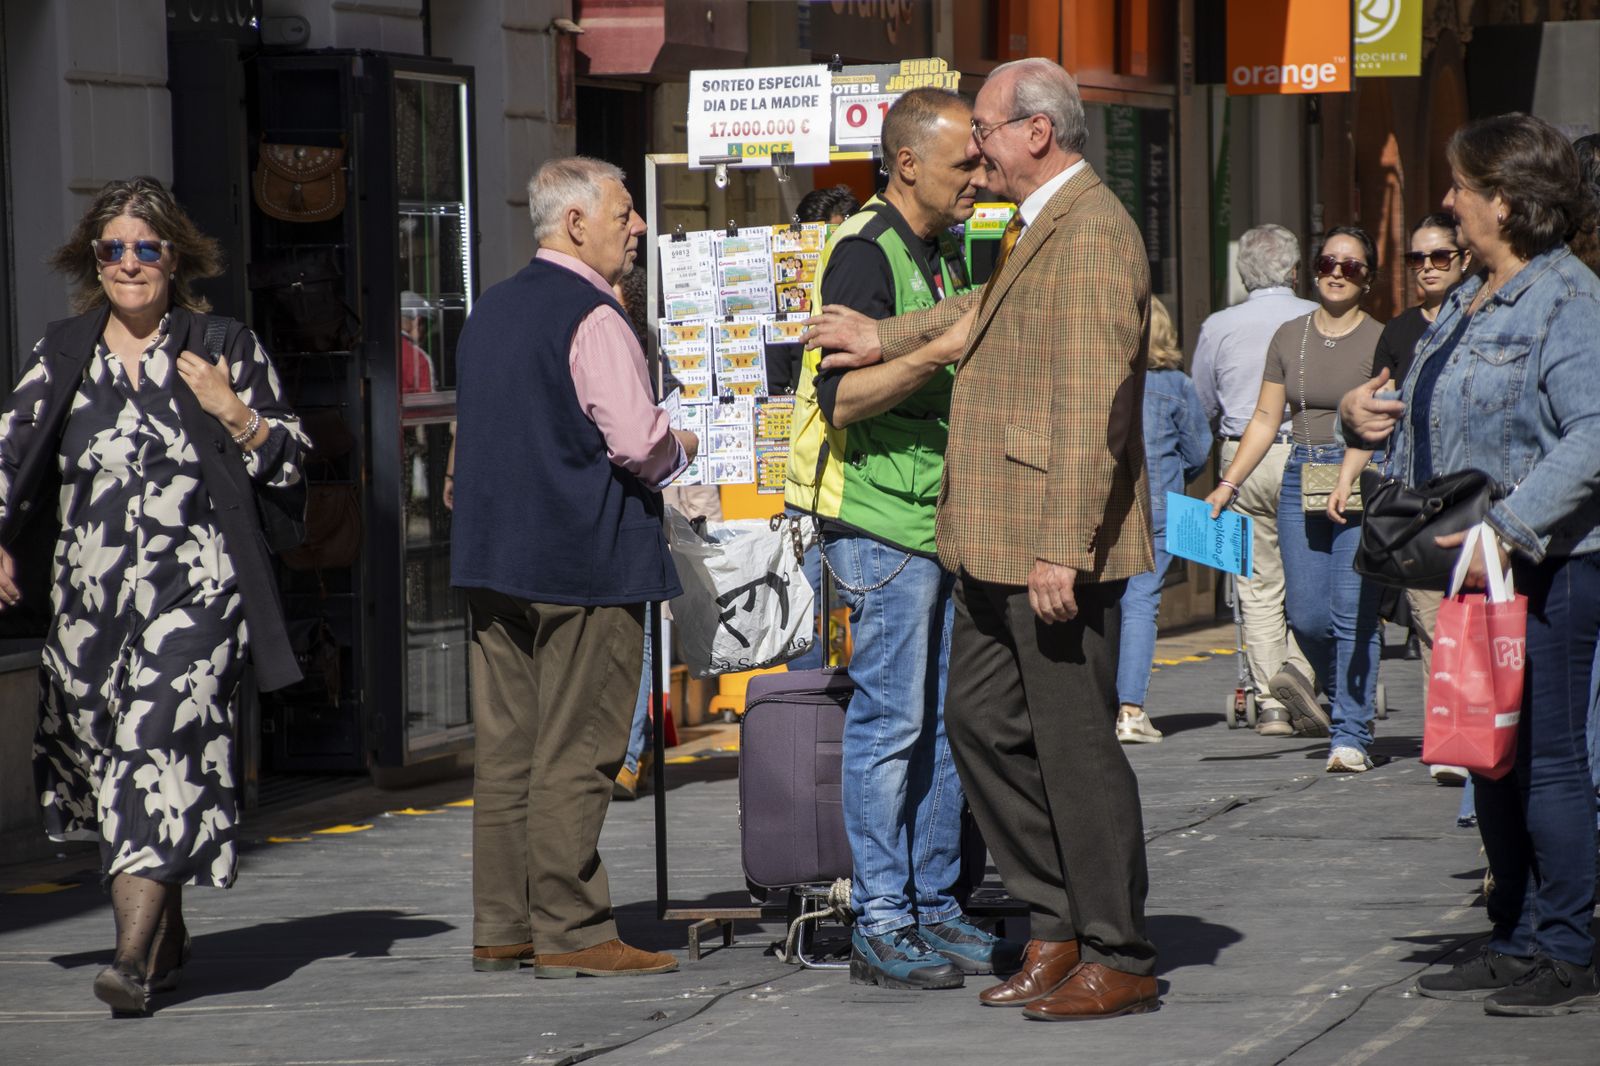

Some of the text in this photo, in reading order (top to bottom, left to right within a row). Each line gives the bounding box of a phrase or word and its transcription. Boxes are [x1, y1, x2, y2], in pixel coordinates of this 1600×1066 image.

[900, 59, 947, 76] EURO
[1232, 62, 1337, 90] orange
[702, 75, 821, 92] SORTEO ESPECIAL
[833, 83, 879, 94] OTE DE
[886, 71, 959, 91] JACKPOT
[703, 94, 819, 112] DIA DE LA MADRE
[709, 118, 810, 137] 17.000.000 €
[746, 143, 791, 155] ONCE
